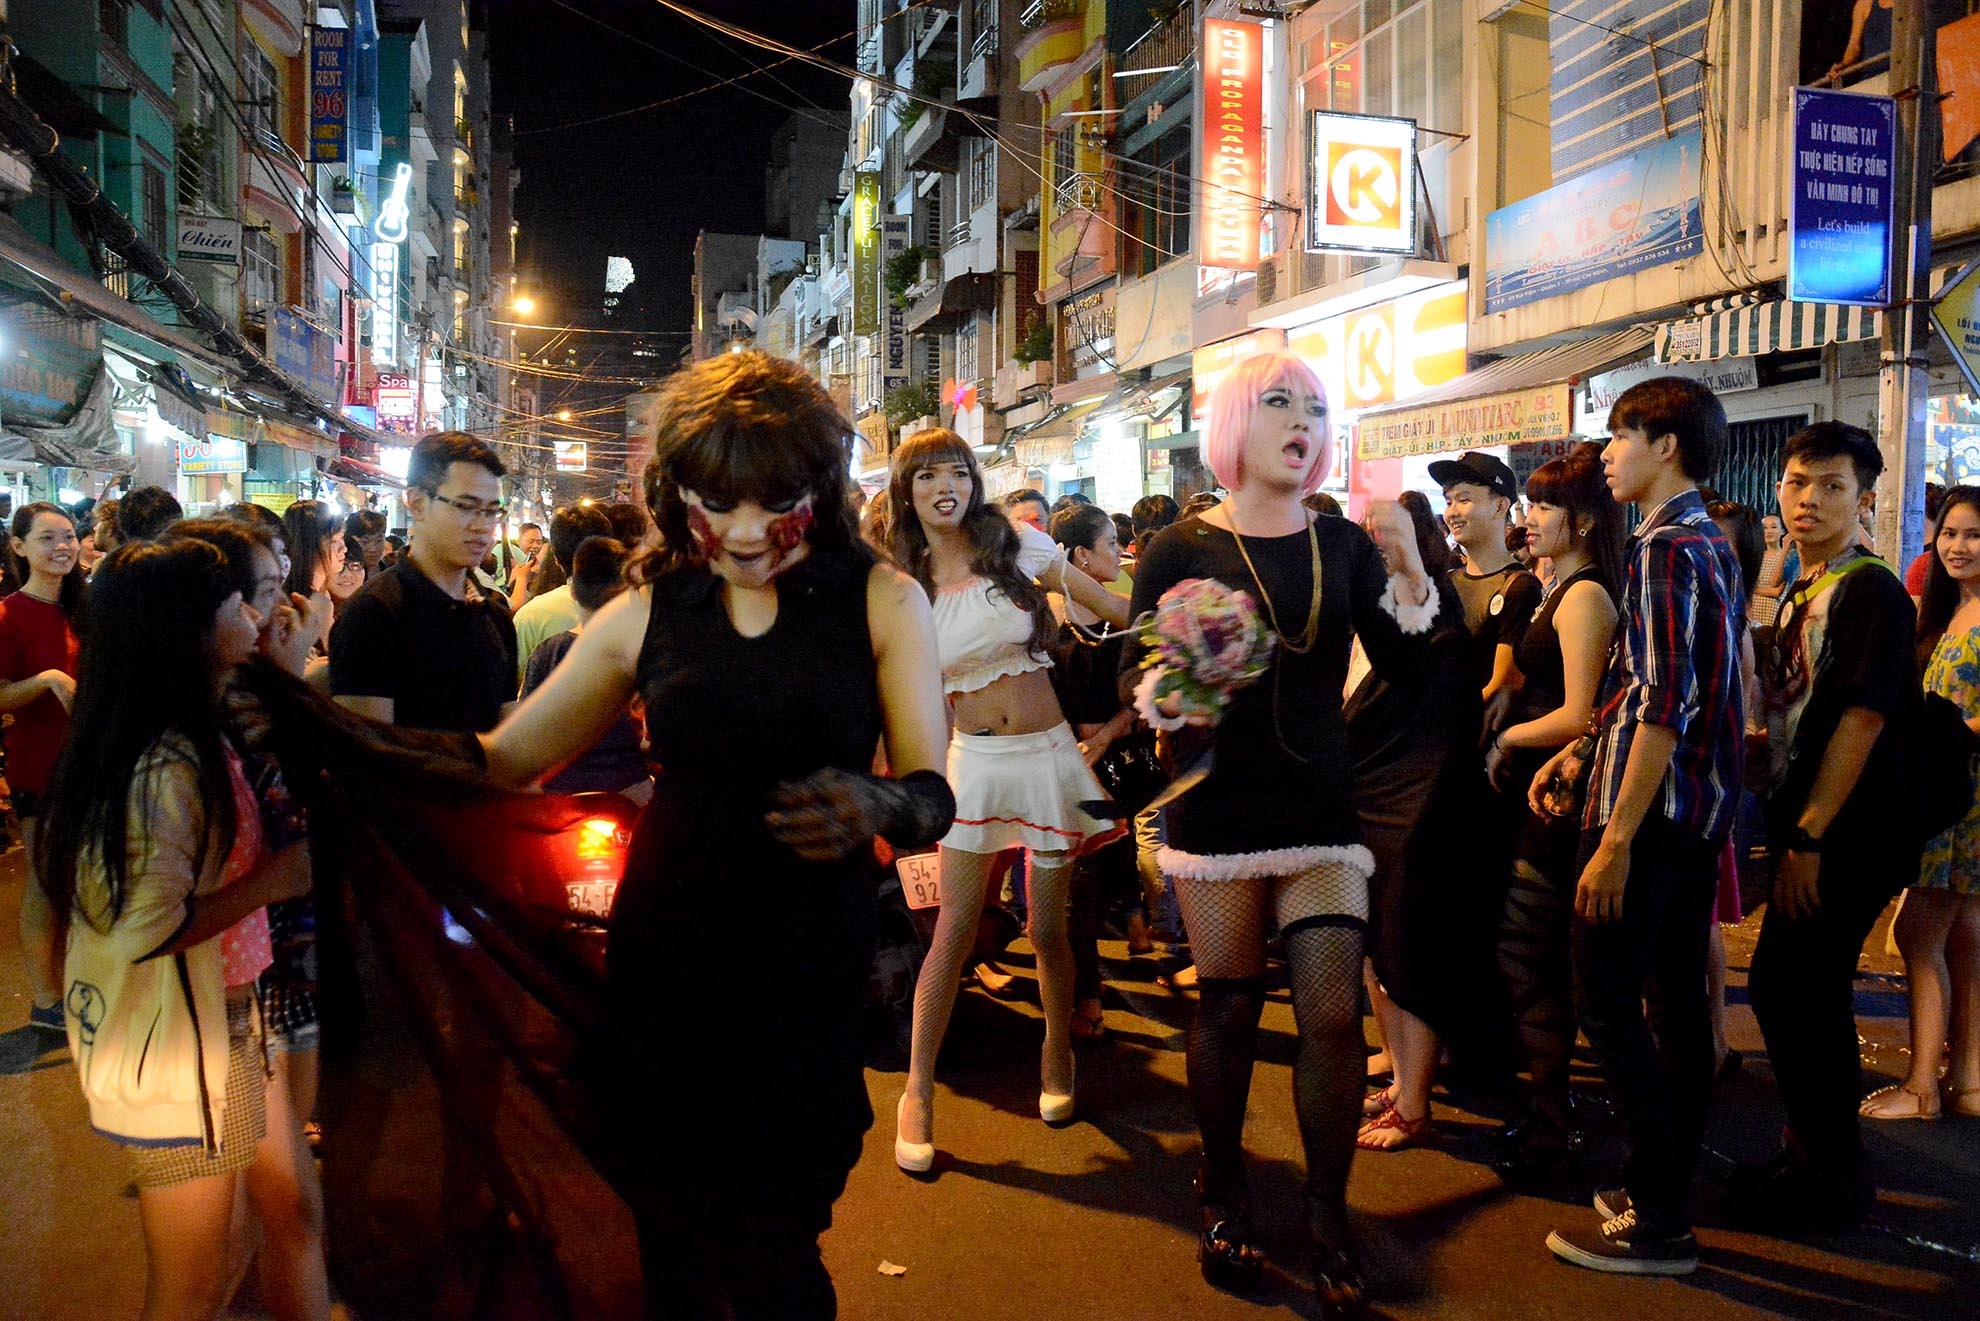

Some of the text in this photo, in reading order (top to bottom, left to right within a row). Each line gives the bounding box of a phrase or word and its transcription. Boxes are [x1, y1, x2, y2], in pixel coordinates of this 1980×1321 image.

[314, 30, 345, 47] ROOM
[1220, 28, 1246, 60] OLD
[318, 51, 339, 67] FOR
[315, 70, 342, 86] RENT
[312, 88, 345, 118] 96
[1219, 67, 1245, 177] PROPAGANDA
[1811, 120, 1878, 147] HÃY CHUNG TAY
[1800, 150, 1888, 178] THỰC HIỆN NẾP SỐNG
[1348, 162, 1393, 219] K
[1826, 183, 1849, 204] MINH
[1851, 184, 1863, 205] ĐÔ
[1865, 186, 1879, 209] THỊ
[860, 175, 873, 259] GRACEFUL
[1818, 216, 1870, 234] Let's build
[1800, 238, 1806, 249] a
[1808, 236, 1854, 252] civilized
[860, 263, 872, 325] SAIGON
[380, 374, 408, 388] Spa
